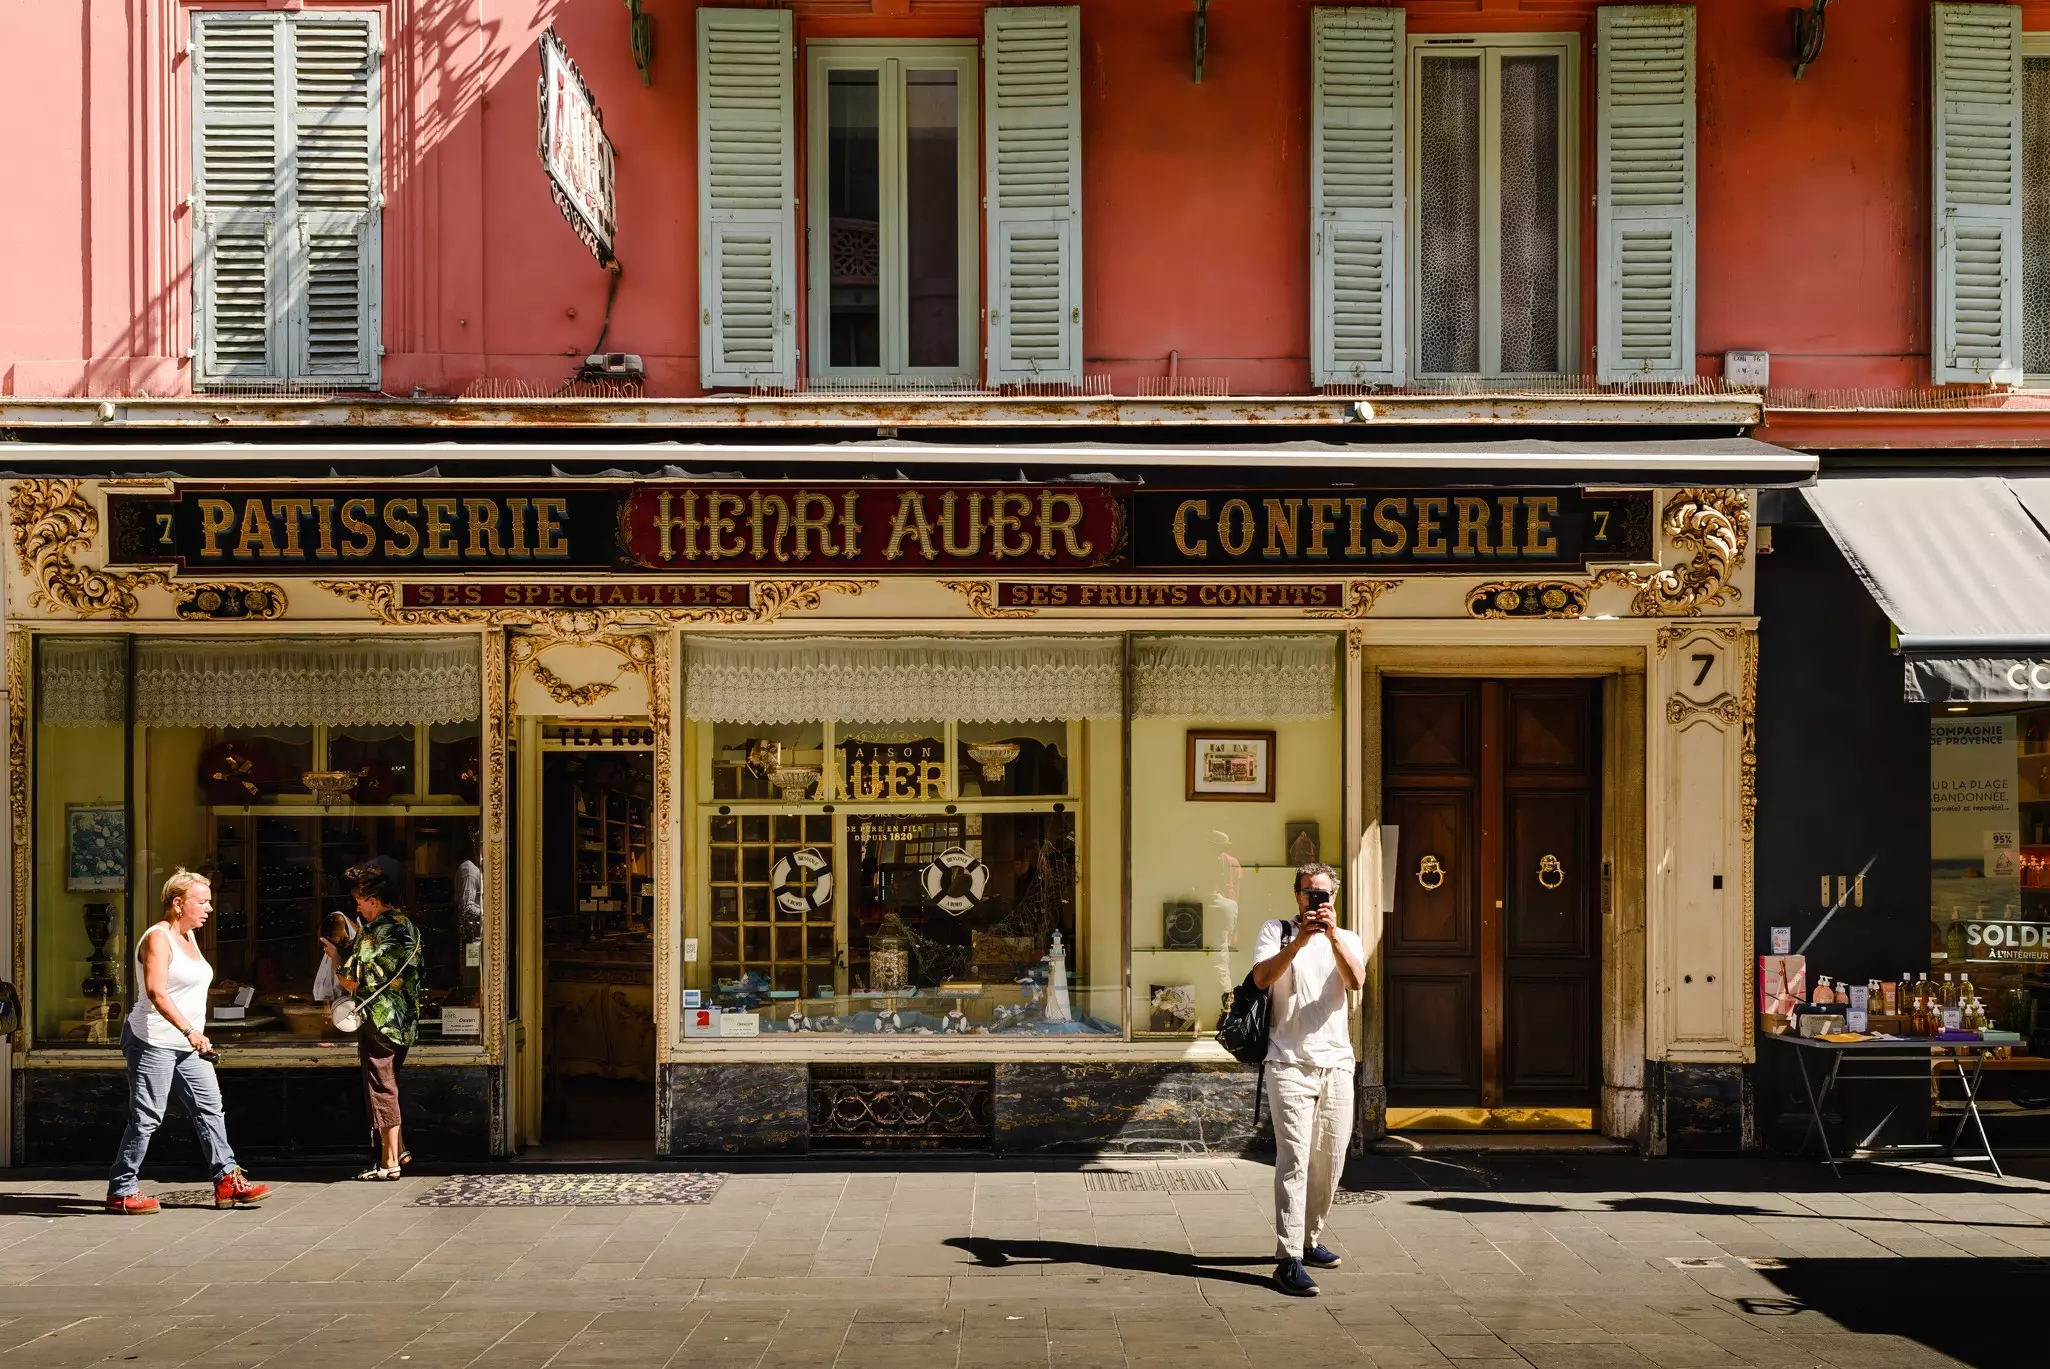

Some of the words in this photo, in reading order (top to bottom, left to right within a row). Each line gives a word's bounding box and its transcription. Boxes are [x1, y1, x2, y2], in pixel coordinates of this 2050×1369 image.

[156, 513, 173, 543] 7
[199, 497, 569, 558] PATISSERIE
[654, 489, 863, 561] HENRI
[883, 489, 1093, 560] AUER
[1172, 496, 1558, 557] CONFISERIE
[1592, 510, 1610, 541] 7
[418, 584, 482, 604] SES
[504, 584, 734, 604] SPECIALITES
[1012, 584, 1068, 605] SES
[1080, 584, 1188, 605] FRUITS
[1200, 584, 1328, 605] CONFITS
[1691, 654, 1715, 686] 7
[2007, 663, 2050, 690] CO
[558, 728, 602, 746] TEA
[1946, 736, 2003, 745] PROVENCE
[836, 747, 932, 757] MAISON
[811, 759, 949, 801] AUER
[1953, 780, 1966, 790] LA
[1970, 779, 2008, 790] PLAGE
[890, 832, 913, 841] 1820
[1993, 834, 2012, 844] 95%
[1967, 923, 2050, 948] SOLDE
[1988, 948, 1996, 958] À
[1997, 950, 2049, 960] L'INTÉRIEUR
